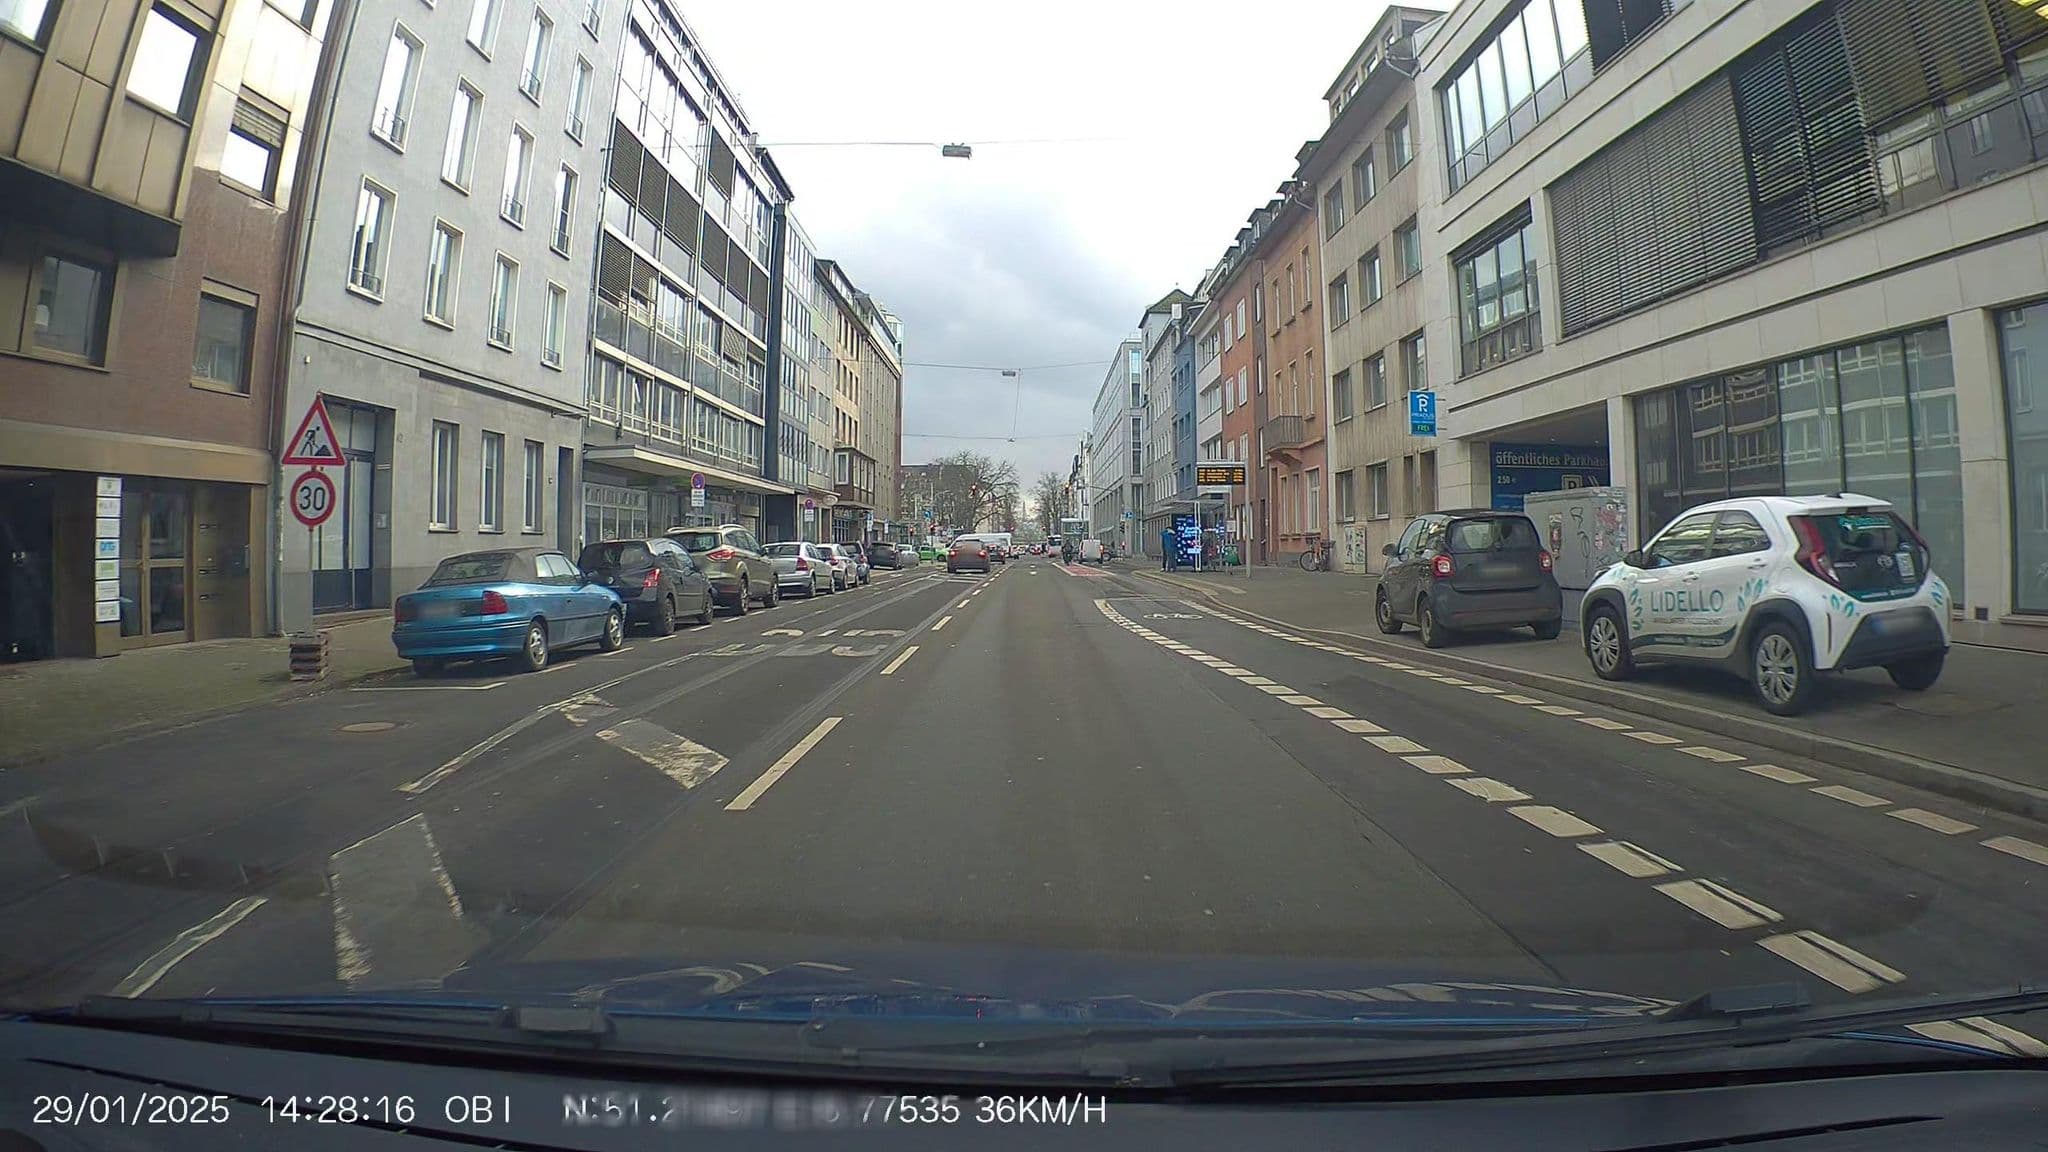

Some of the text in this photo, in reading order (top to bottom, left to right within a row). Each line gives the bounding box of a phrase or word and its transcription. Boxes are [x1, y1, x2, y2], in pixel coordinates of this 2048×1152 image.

[1496, 451, 1560, 466] öffentliches
[299, 485, 326, 511] 30
[1650, 589, 1725, 613] LIDELLO
